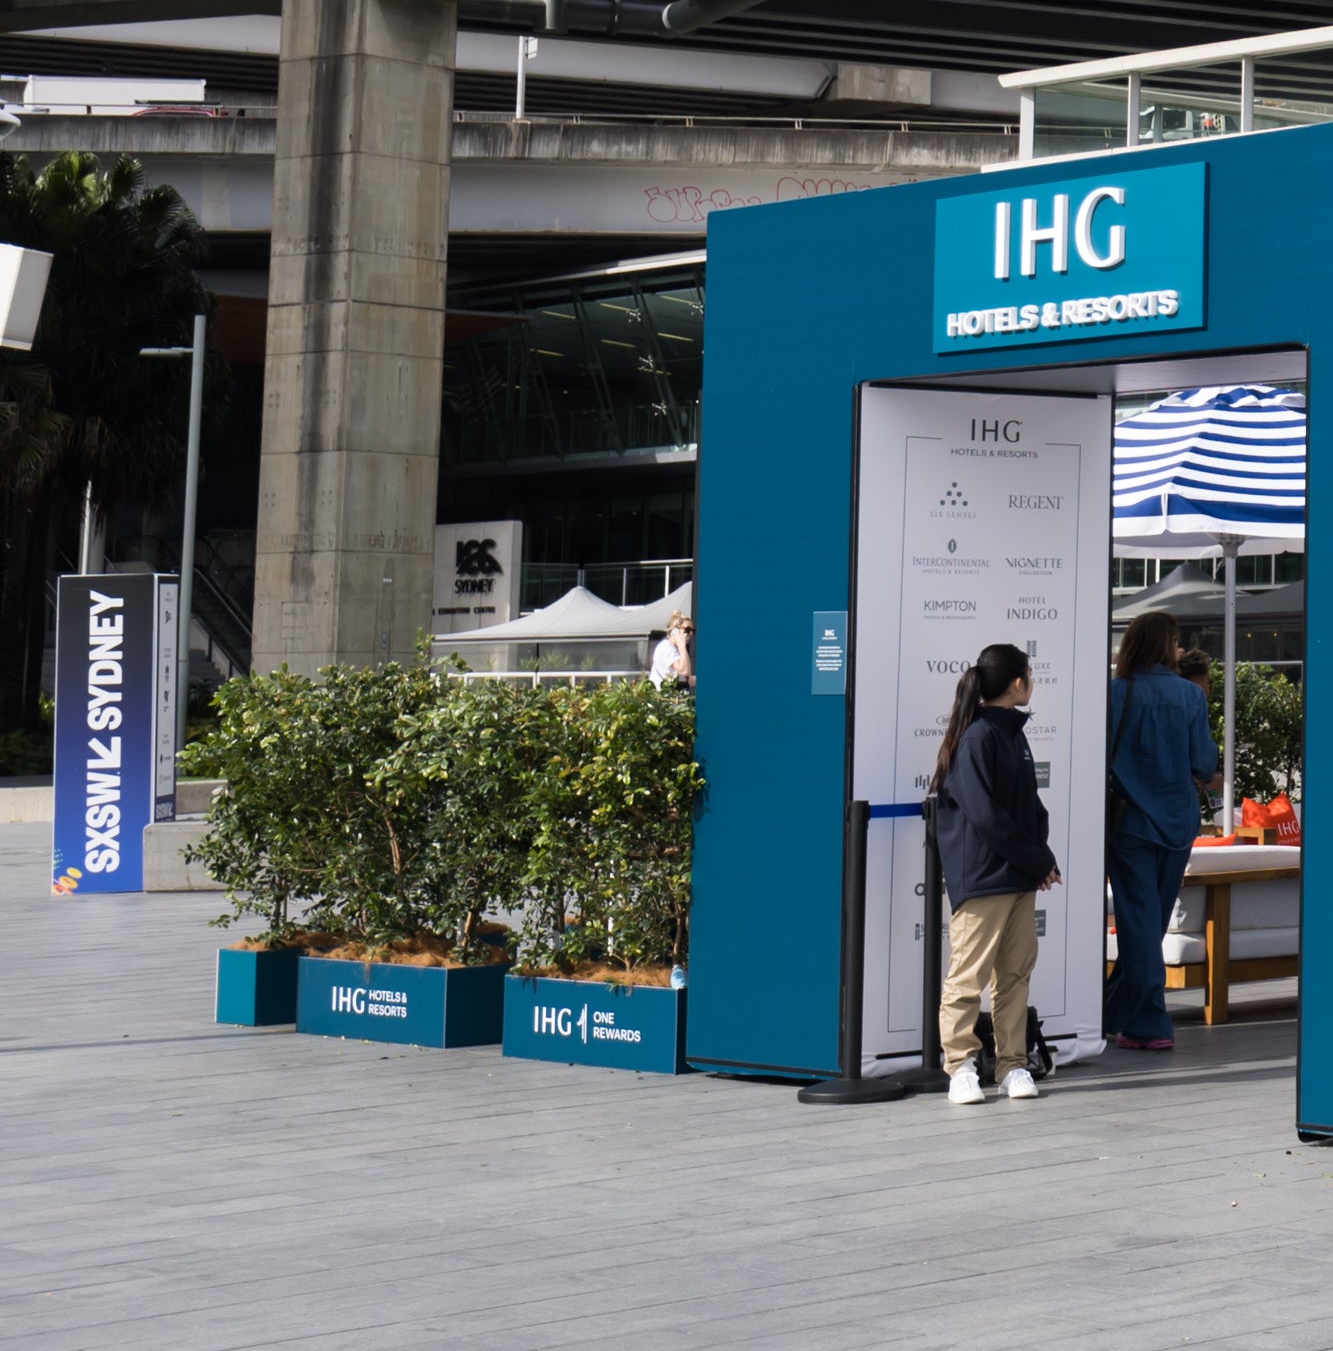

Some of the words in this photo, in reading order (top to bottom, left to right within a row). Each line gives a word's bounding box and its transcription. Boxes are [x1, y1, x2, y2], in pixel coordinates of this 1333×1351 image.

[994, 186, 1126, 279] IHG
[947, 304, 1039, 337] HOTELS
[1040, 302, 1061, 328] &
[1061, 289, 1180, 326] RESORTS
[971, 418, 1022, 443] IHG
[951, 448, 987, 457] HOTELS
[997, 450, 1039, 459] RESORTS
[1008, 494, 1063, 510] REGENT
[1005, 557, 1064, 570] VIGNETTE
[454, 578, 496, 595] SYDNEY
[923, 600, 977, 612] KIMPTON
[1006, 608, 1058, 621] INDIGO
[86, 589, 125, 731] SYDNEY
[85, 768, 121, 874] SXSW
[332, 985, 366, 1014] IHG
[368, 989, 401, 1003] HOTELS
[401, 992, 407, 1004] &
[368, 1003, 407, 1018] RESORTS
[534, 1005, 572, 1036] IHG
[593, 1010, 615, 1024] ONE
[593, 1026, 641, 1043] REWARDS
